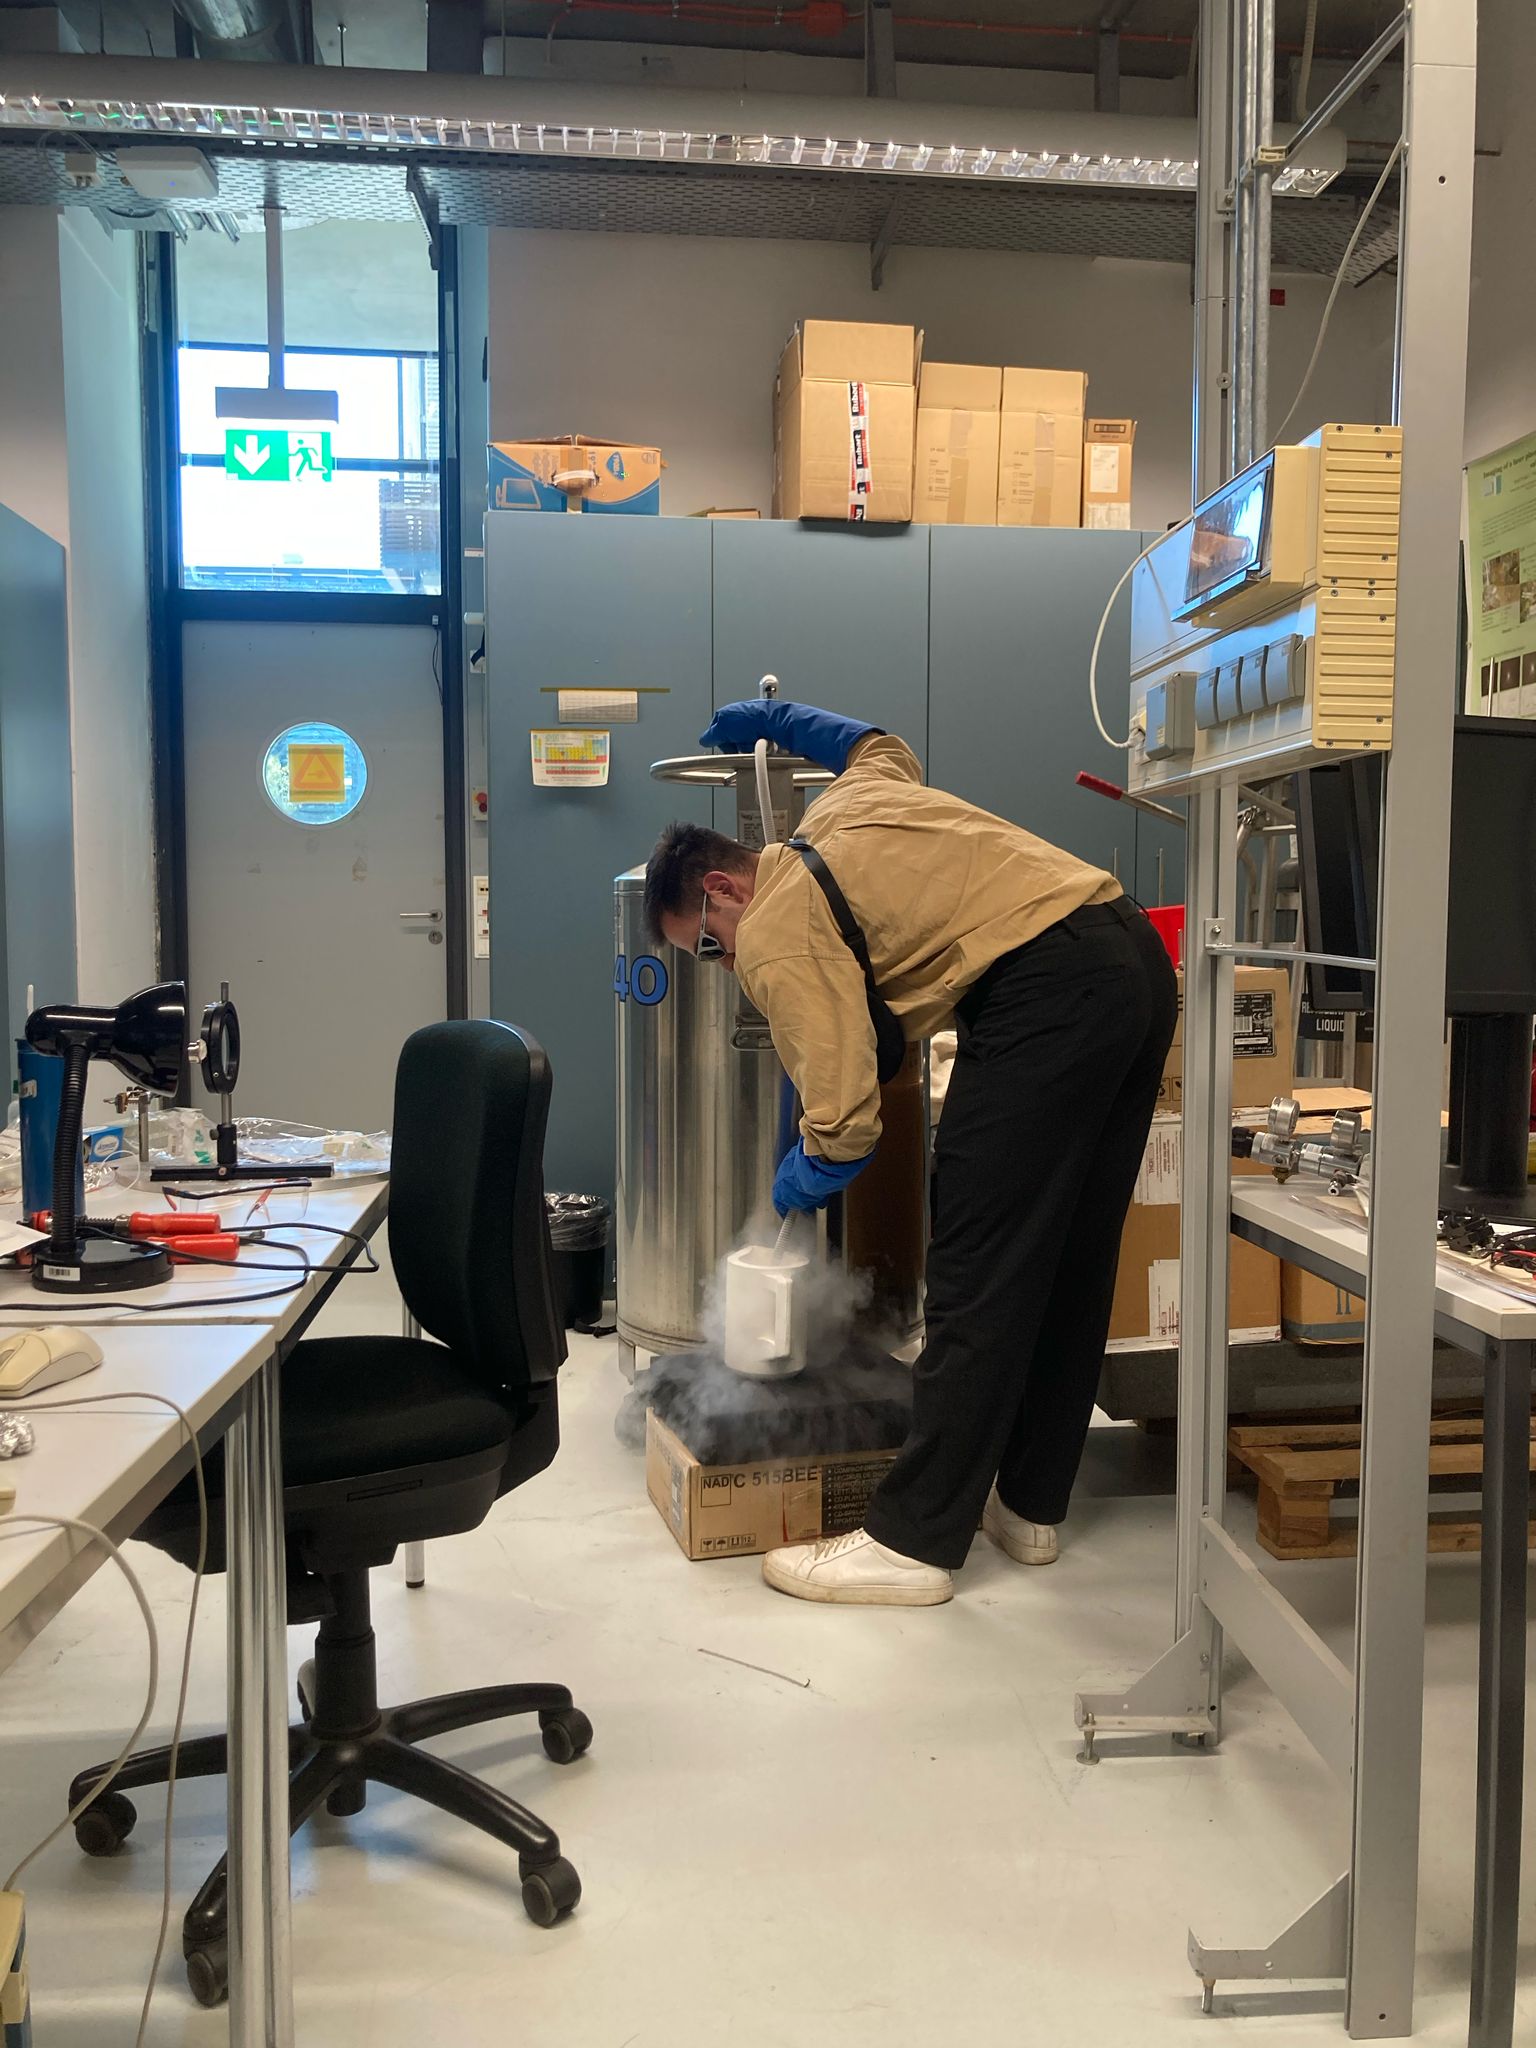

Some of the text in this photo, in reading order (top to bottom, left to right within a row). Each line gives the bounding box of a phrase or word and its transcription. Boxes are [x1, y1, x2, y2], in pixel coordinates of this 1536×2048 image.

[854, 433, 863, 465] Rubart
[613, 954, 668, 1006] 40
[1316, 1018, 1345, 1032] LIQUID
[703, 1465, 818, 1489] NAD C 515BEE
